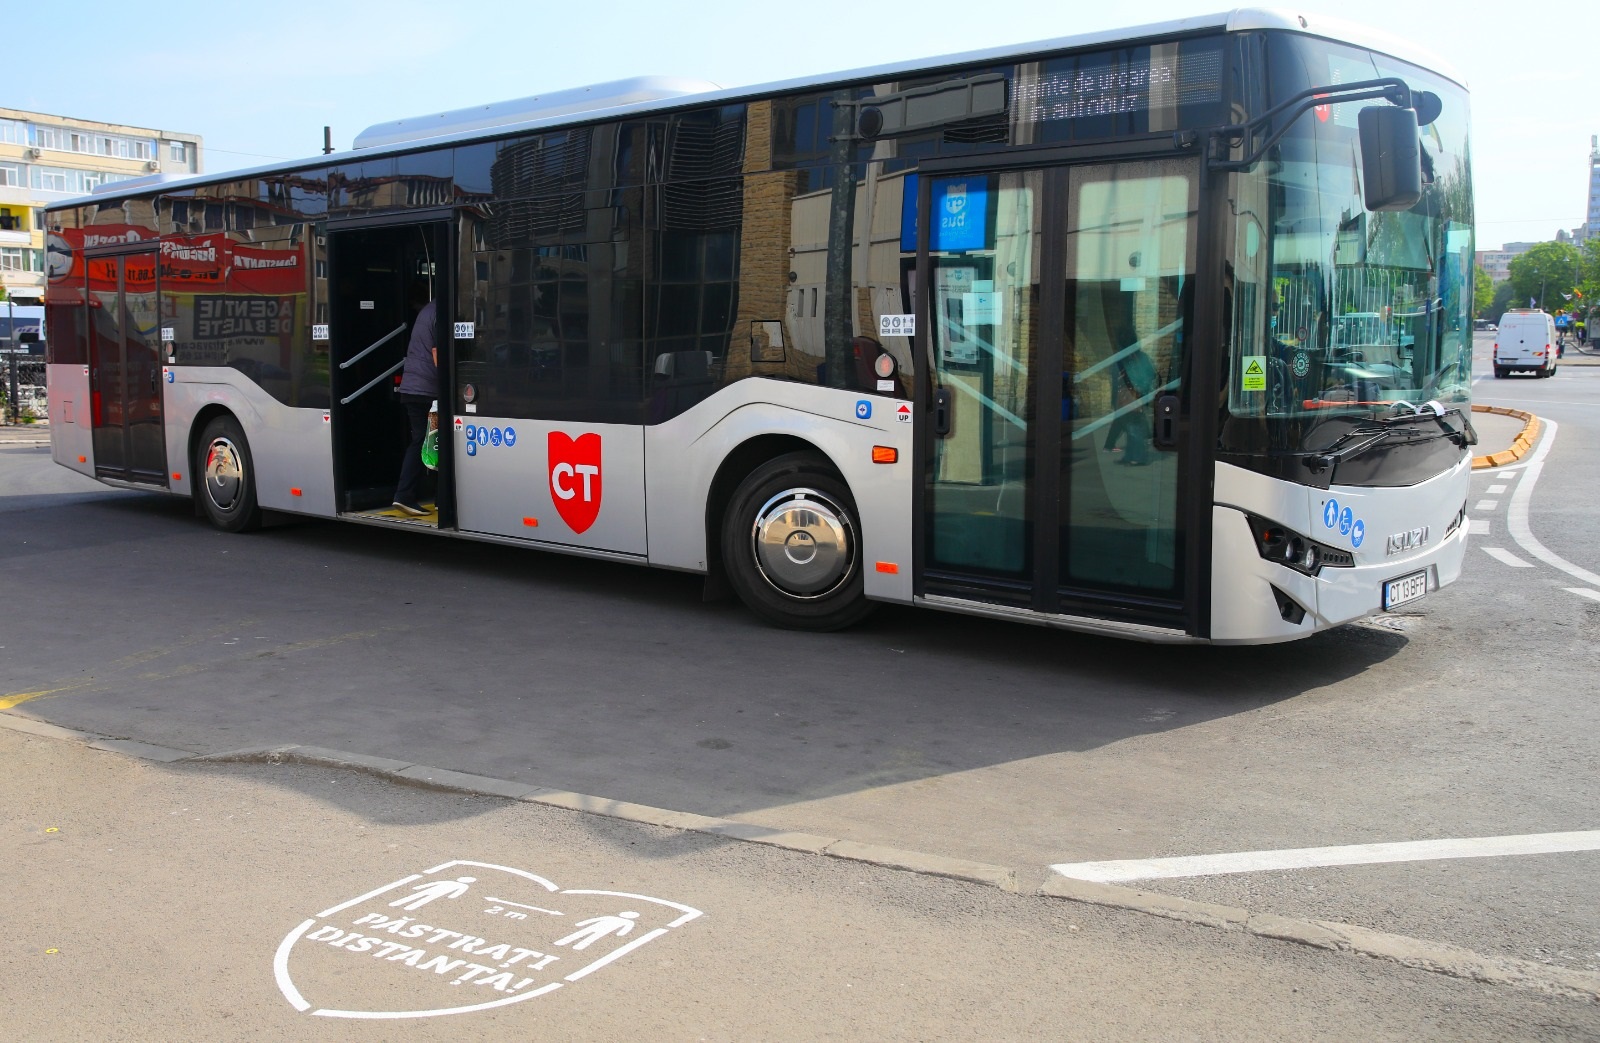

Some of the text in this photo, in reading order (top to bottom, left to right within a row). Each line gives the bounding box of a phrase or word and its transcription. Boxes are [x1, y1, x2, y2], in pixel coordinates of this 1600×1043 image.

[1073, 71, 1094, 93] de
[1052, 94, 1138, 120] autobuz
[898, 414, 909, 422] UP
[551, 462, 599, 502] CT
[1386, 525, 1430, 555] ISUZU
[1390, 575, 1425, 602] CT 13 BFF
[483, 905, 527, 920] 2 m
[305, 925, 535, 994] DISTANȚA!
